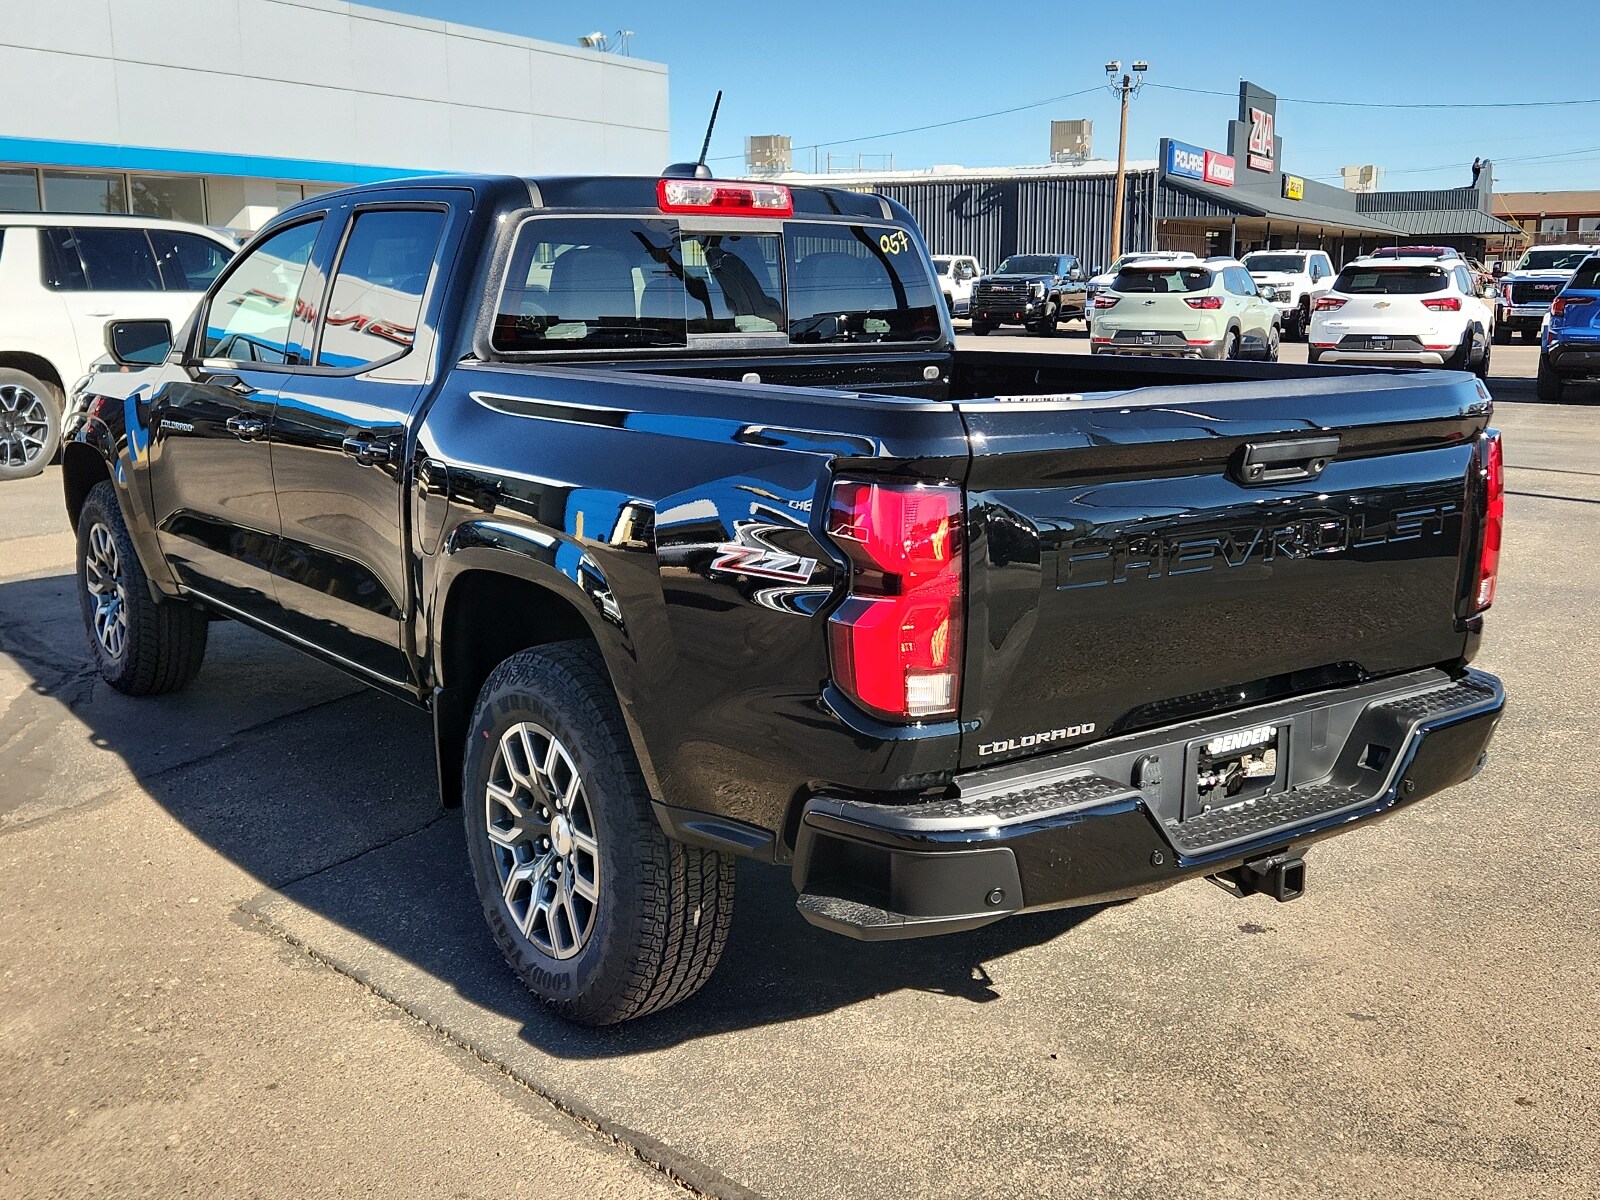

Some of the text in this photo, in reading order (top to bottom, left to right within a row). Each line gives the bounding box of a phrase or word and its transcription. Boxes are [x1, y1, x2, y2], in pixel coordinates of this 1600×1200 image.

[1174, 150, 1203, 172] POLARIS
[880, 231, 909, 255] 057
[1056, 503, 1457, 591] CHEVROLET
[709, 544, 817, 584] Z71
[978, 722, 1095, 755] COLORADO
[1211, 726, 1270, 754] BENDER
